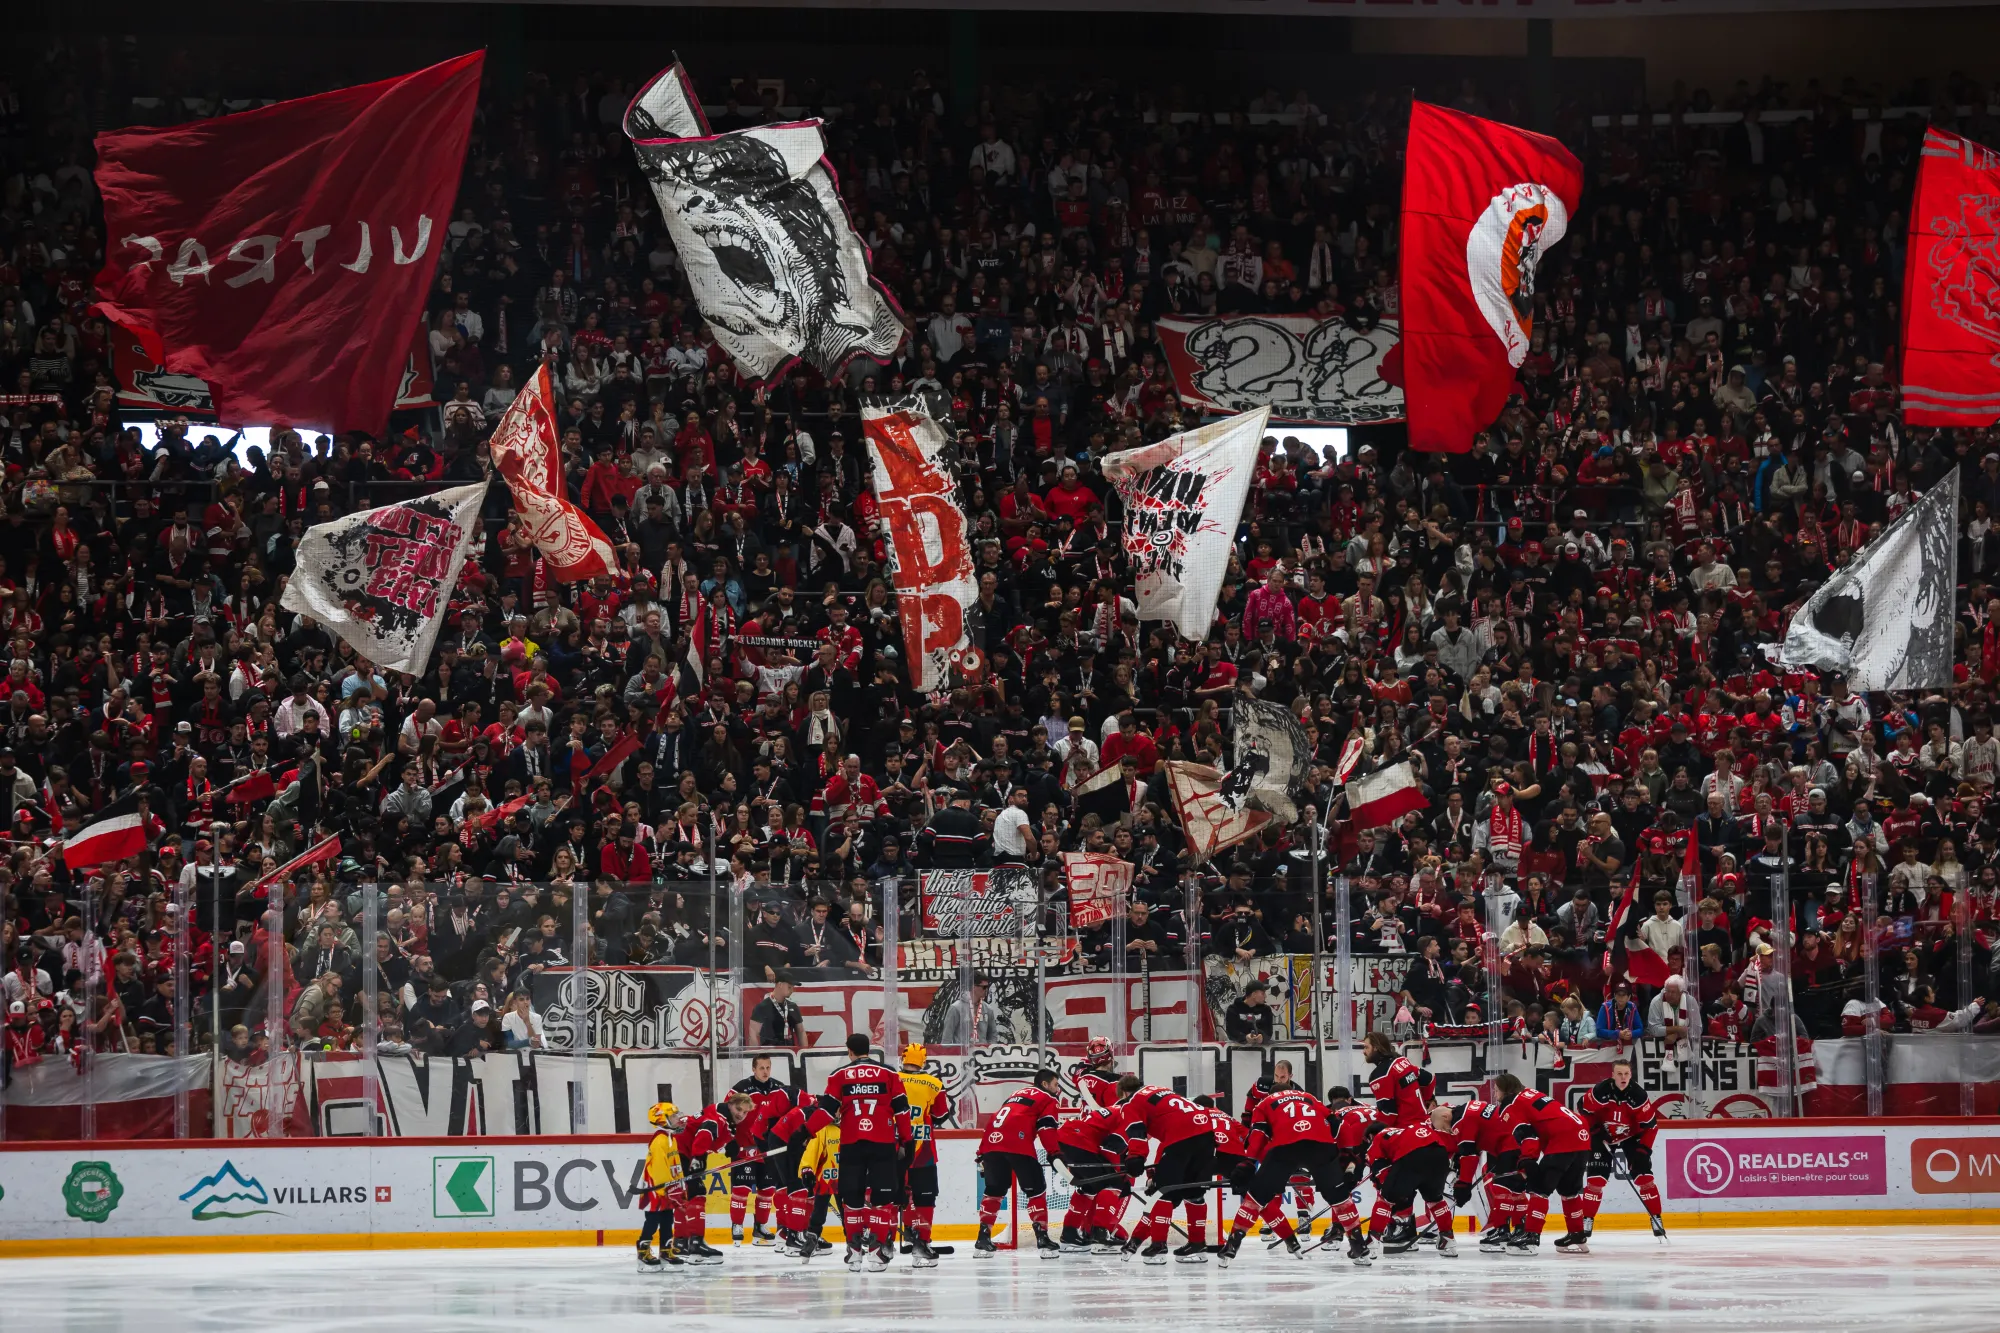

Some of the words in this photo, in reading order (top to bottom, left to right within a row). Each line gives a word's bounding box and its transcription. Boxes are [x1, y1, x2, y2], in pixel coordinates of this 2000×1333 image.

[599, 604, 609, 614] 24
[746, 636, 786, 646] LAUSANNE
[787, 638, 817, 649] HOCKEY
[558, 968, 646, 1016] Old
[541, 1003, 674, 1050] School
[1643, 1039, 1733, 1059] CORE
[858, 1068, 881, 1078] BCV
[850, 1083, 879, 1094] JÄGER
[852, 1099, 878, 1117] 17
[993, 1106, 1011, 1128] 9
[1613, 1111, 1622, 1122] 11
[513, 1159, 646, 1212] BCV
[1740, 1174, 1768, 1182] Loisirs
[1781, 1172, 1824, 1182] bien-être
[1826, 1174, 1846, 1184] pour
[1848, 1172, 1870, 1181] tous
[273, 1186, 367, 1204] VILLARS
